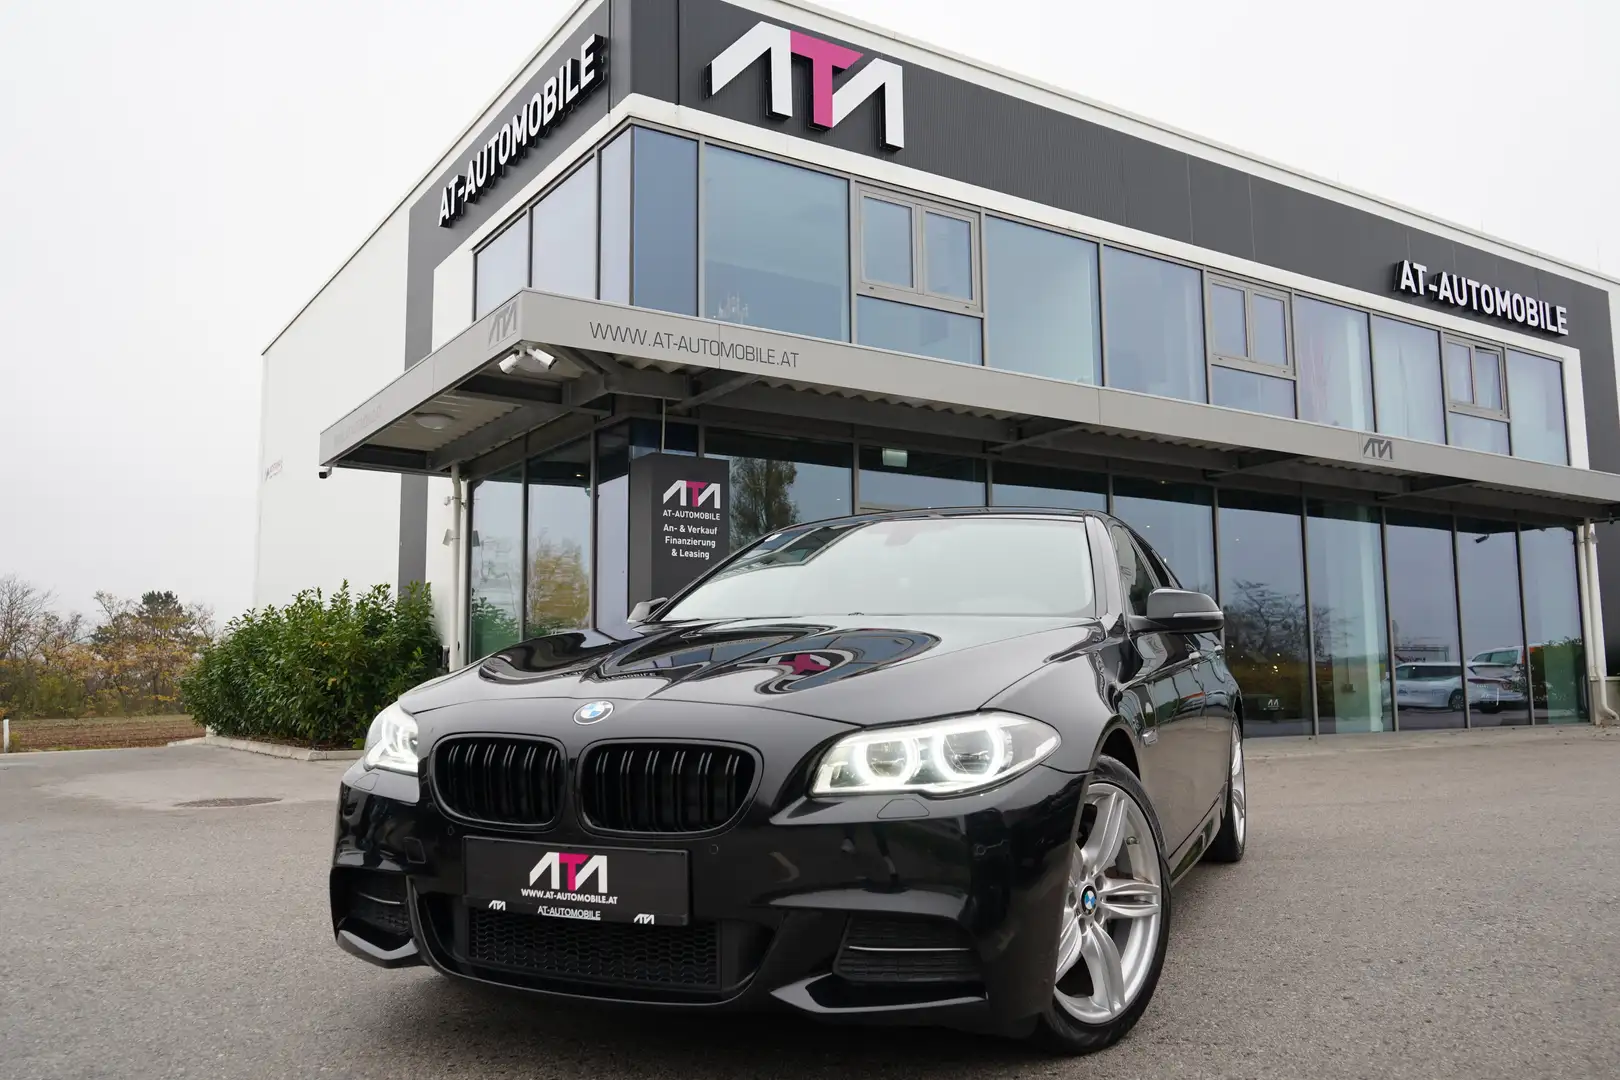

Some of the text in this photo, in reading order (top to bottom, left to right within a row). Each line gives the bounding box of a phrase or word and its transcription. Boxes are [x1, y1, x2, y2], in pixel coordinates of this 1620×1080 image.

[711, 21, 904, 149] ATA
[439, 33, 600, 227] AT-AUTOMOBILE
[1400, 259, 1568, 335] AT-AUTOMOBILE
[589, 321, 799, 368] WWW.AT-AUTOMOBILE.AT
[662, 479, 720, 509] ATA
[662, 509, 720, 520] AT-AUTOMOBILE
[663, 523, 718, 535] An- & Verkauf
[664, 535, 716, 548] Finanzierung
[671, 548, 710, 560] & Leasing
[529, 851, 608, 894] ATA
[521, 888, 618, 904] WWW.AT-AUTOMOBILE.AT
[537, 905, 601, 919] AT-AUTOMOBILE
